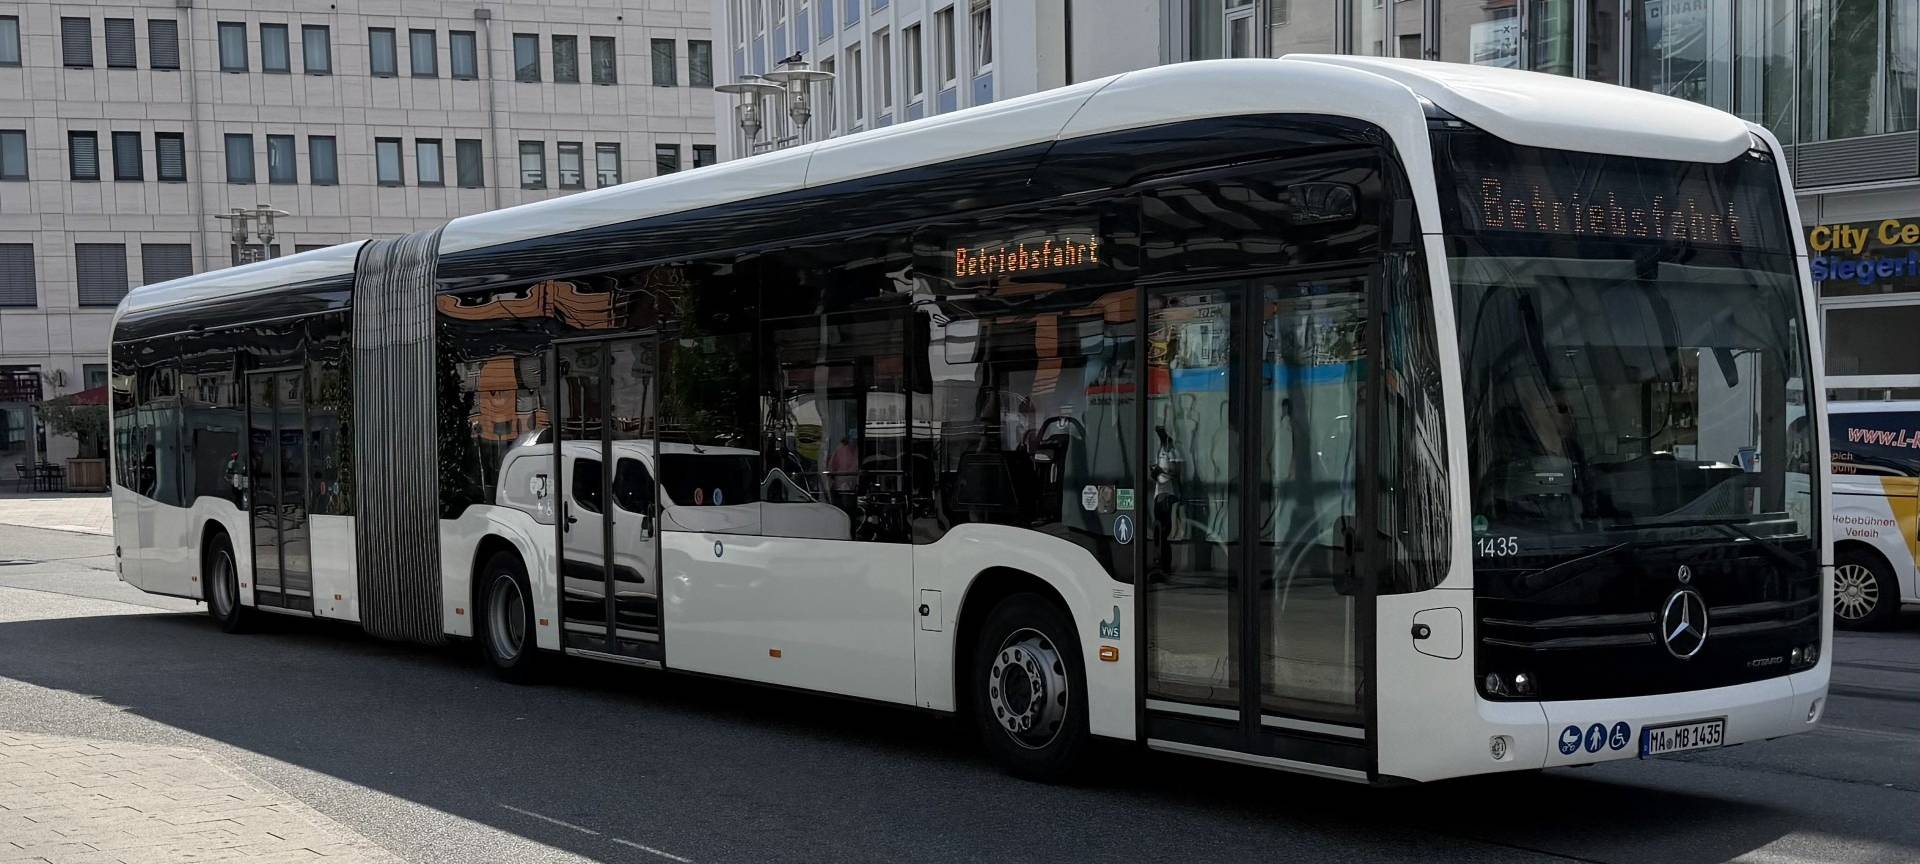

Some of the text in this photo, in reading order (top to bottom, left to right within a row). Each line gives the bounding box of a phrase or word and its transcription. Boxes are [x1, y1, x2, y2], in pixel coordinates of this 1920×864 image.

[1481, 176, 1742, 243] Betriebsfahrt
[1809, 218, 1920, 255] City Ce
[956, 234, 1098, 277] Betriebsfahrt
[1477, 536, 1518, 557] 1435
[1650, 731, 1665, 752] MA
[1674, 728, 1690, 748] MB
[1691, 723, 1721, 747] 1435
